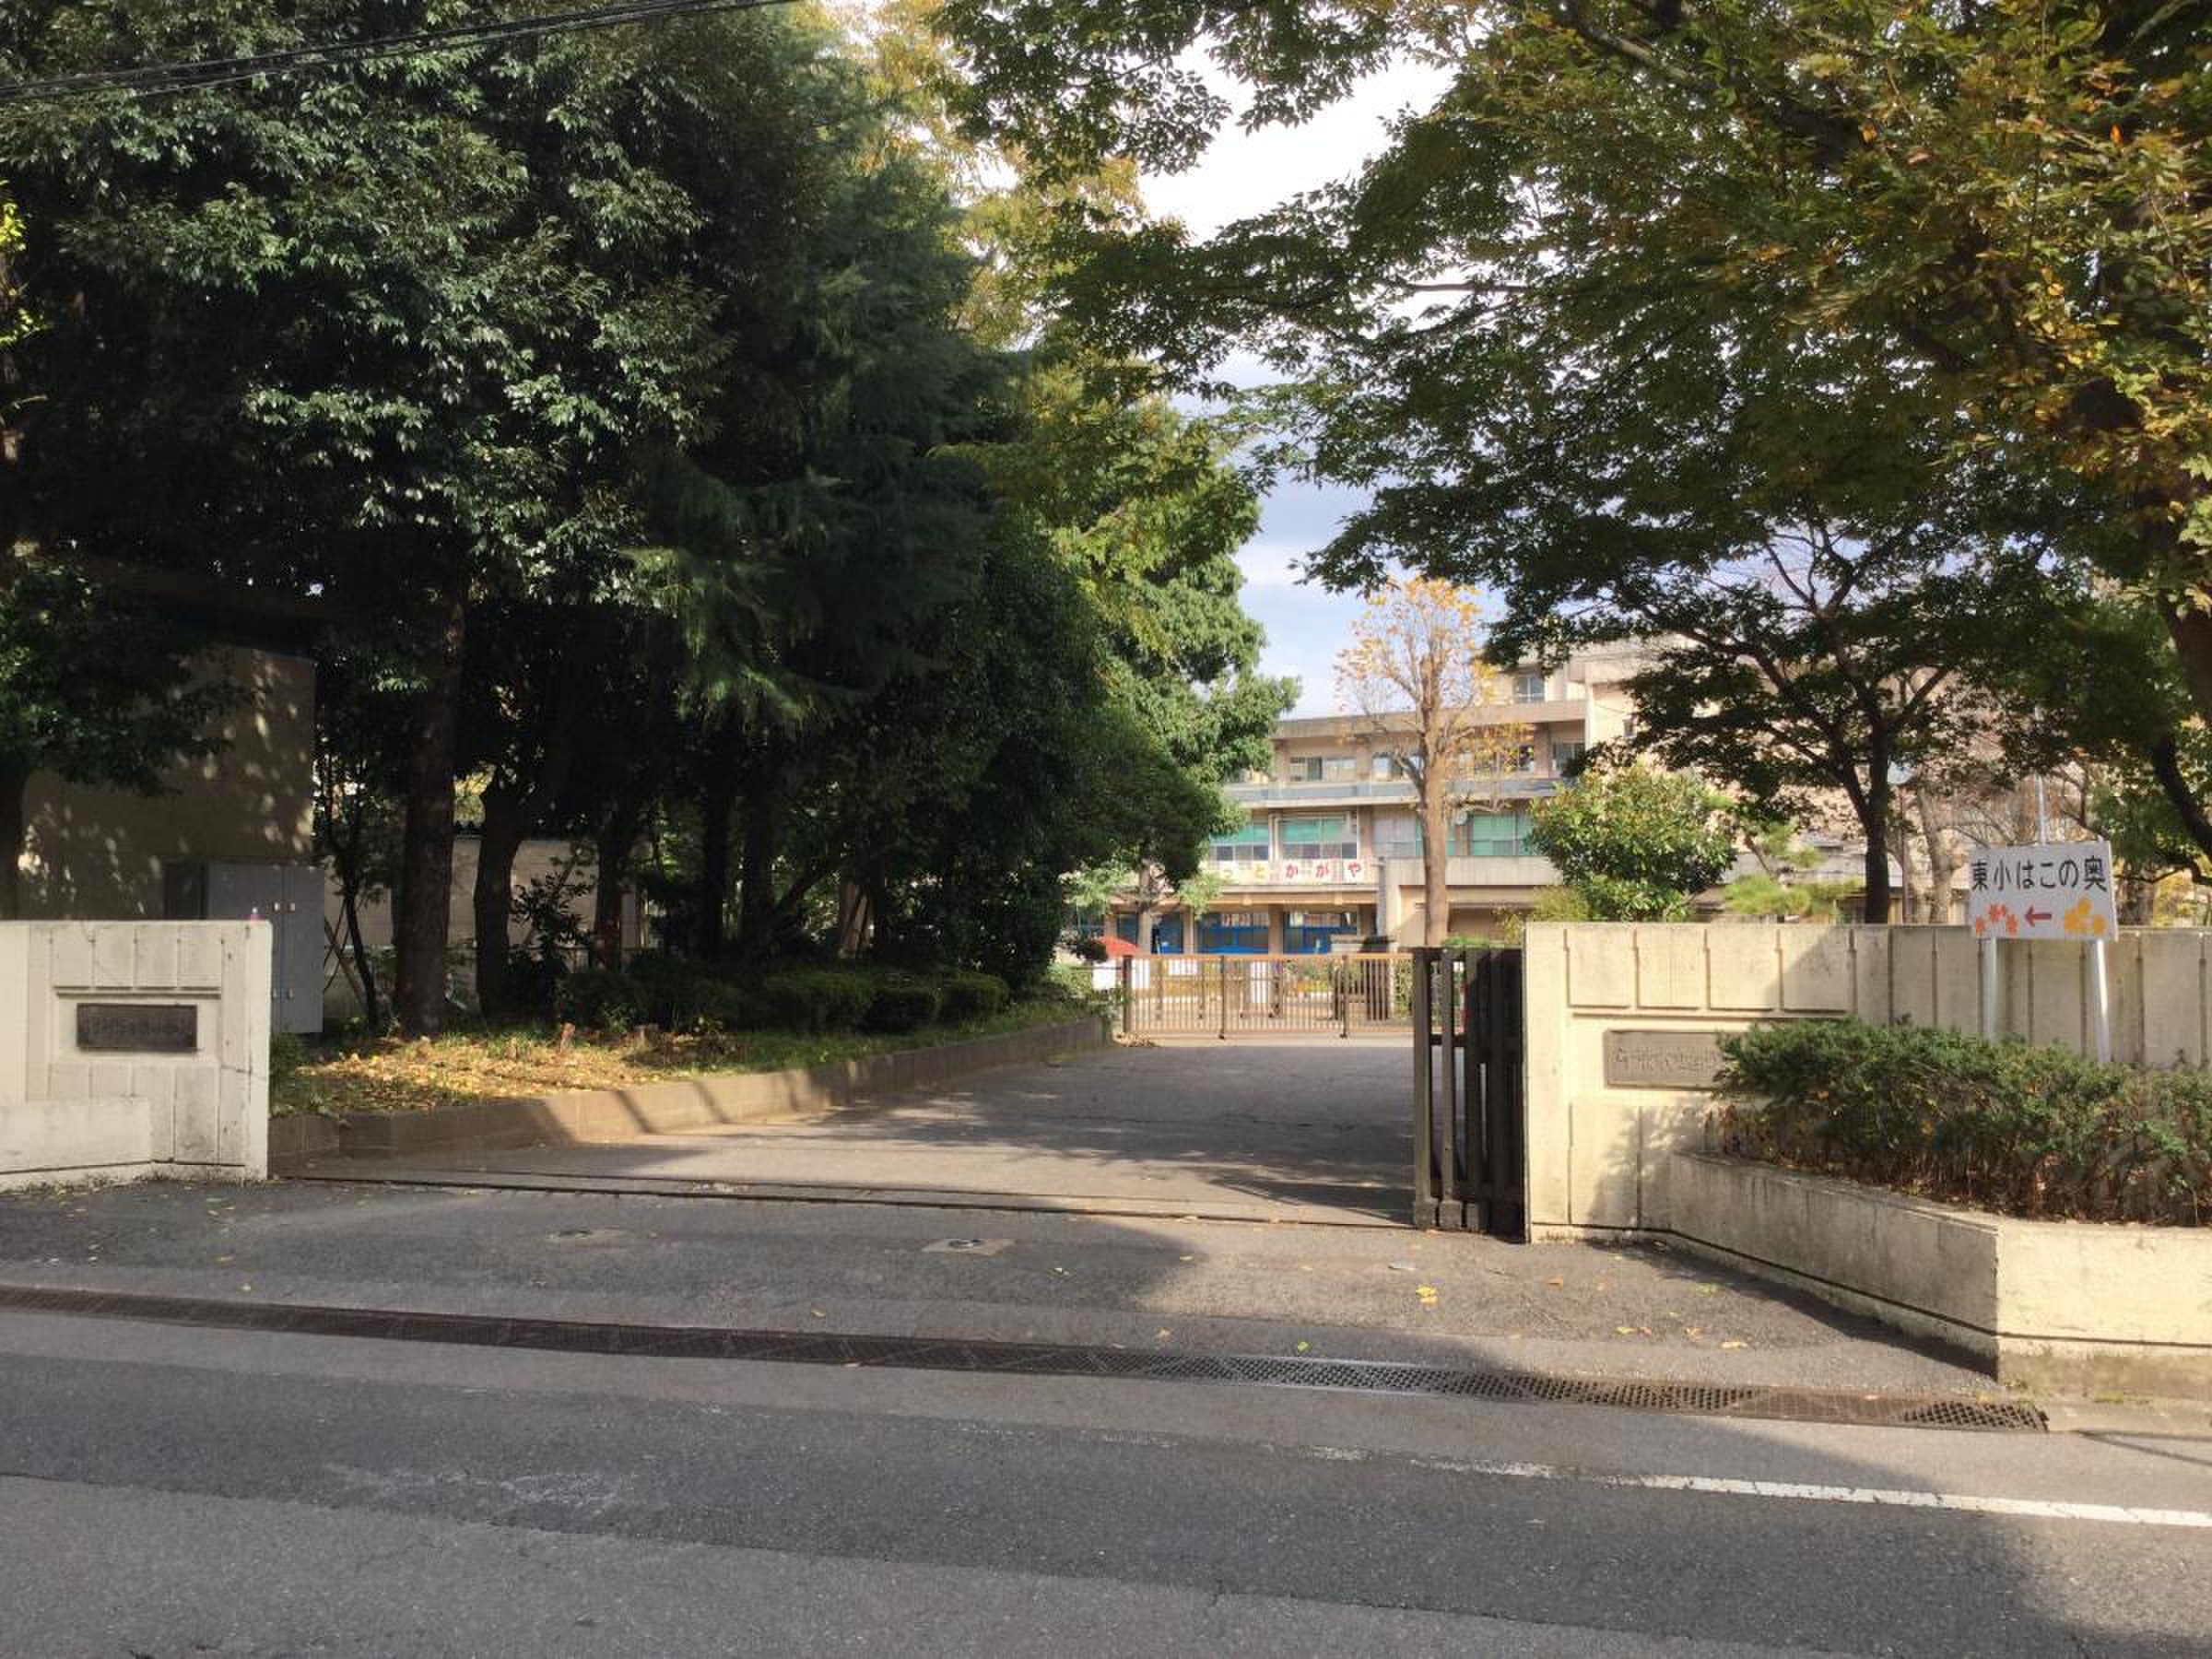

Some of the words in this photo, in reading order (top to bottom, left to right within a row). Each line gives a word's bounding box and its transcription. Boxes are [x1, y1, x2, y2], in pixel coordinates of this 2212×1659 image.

[1971, 855, 2107, 892] 東小はこの奥
